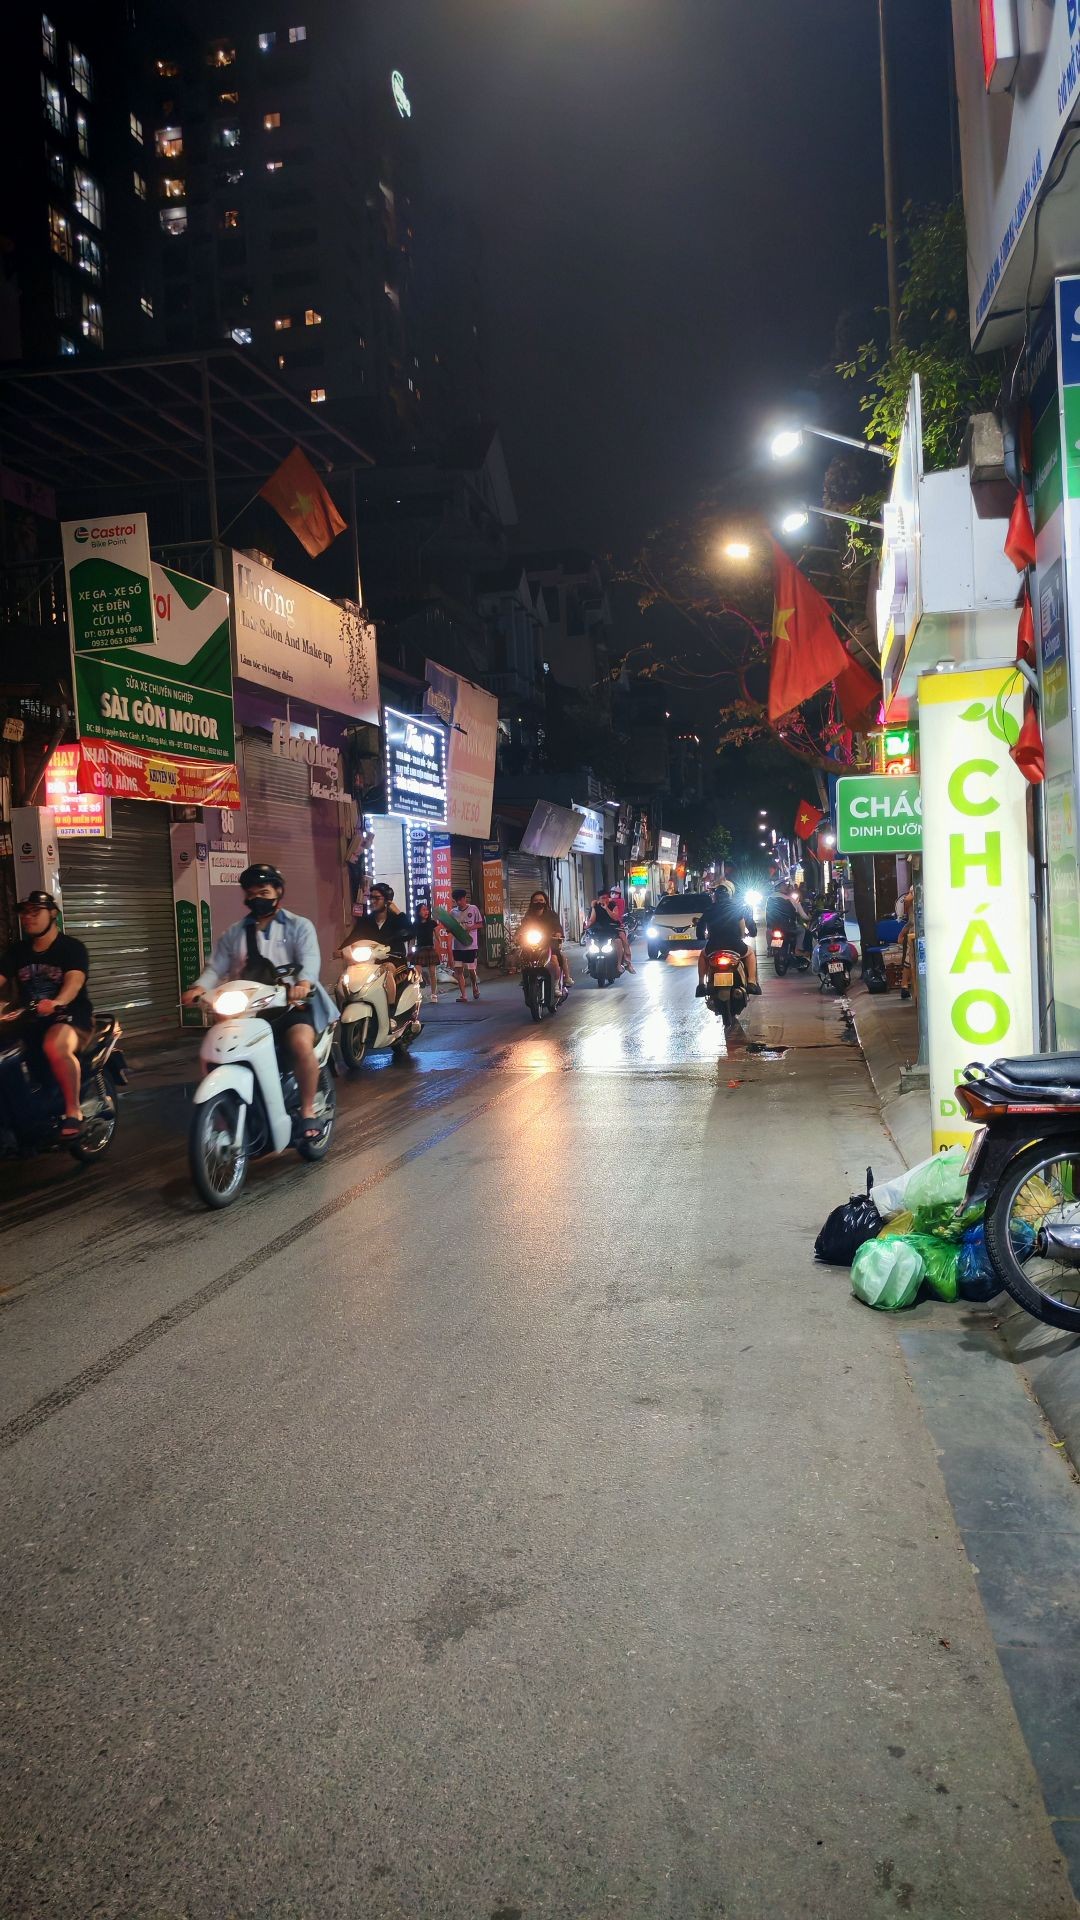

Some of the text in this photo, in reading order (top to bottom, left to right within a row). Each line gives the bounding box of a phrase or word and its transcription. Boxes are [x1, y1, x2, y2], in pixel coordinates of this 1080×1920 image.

[91, 524, 136, 539] Castrol
[91, 538, 127, 549] Bike Point
[79, 591, 90, 600] XE
[93, 590, 106, 600] GA
[114, 587, 127, 596] XE
[128, 583, 141, 594] SỐ
[236, 562, 295, 629] Hương
[92, 599, 130, 613] XE ĐIỆN
[117, 612, 132, 624] HỘ
[116, 628, 128, 636] 451
[91, 638, 108, 647] 0932
[260, 618, 284, 644] Salon
[285, 632, 300, 652] And
[302, 638, 322, 659] Make
[323, 649, 333, 669] up
[140, 681, 148, 691] XE
[149, 684, 171, 699] CHUYÊN
[173, 690, 194, 705] NGHIỆP
[101, 687, 130, 722] SÀI
[132, 696, 167, 730] GÒN
[169, 708, 219, 740] MOTOR
[220, 810, 234, 834] 86
[850, 823, 923, 837] DINH DƯỠN
[947, 758, 1011, 1045] CHÁO
[491, 943, 501, 958] XE
